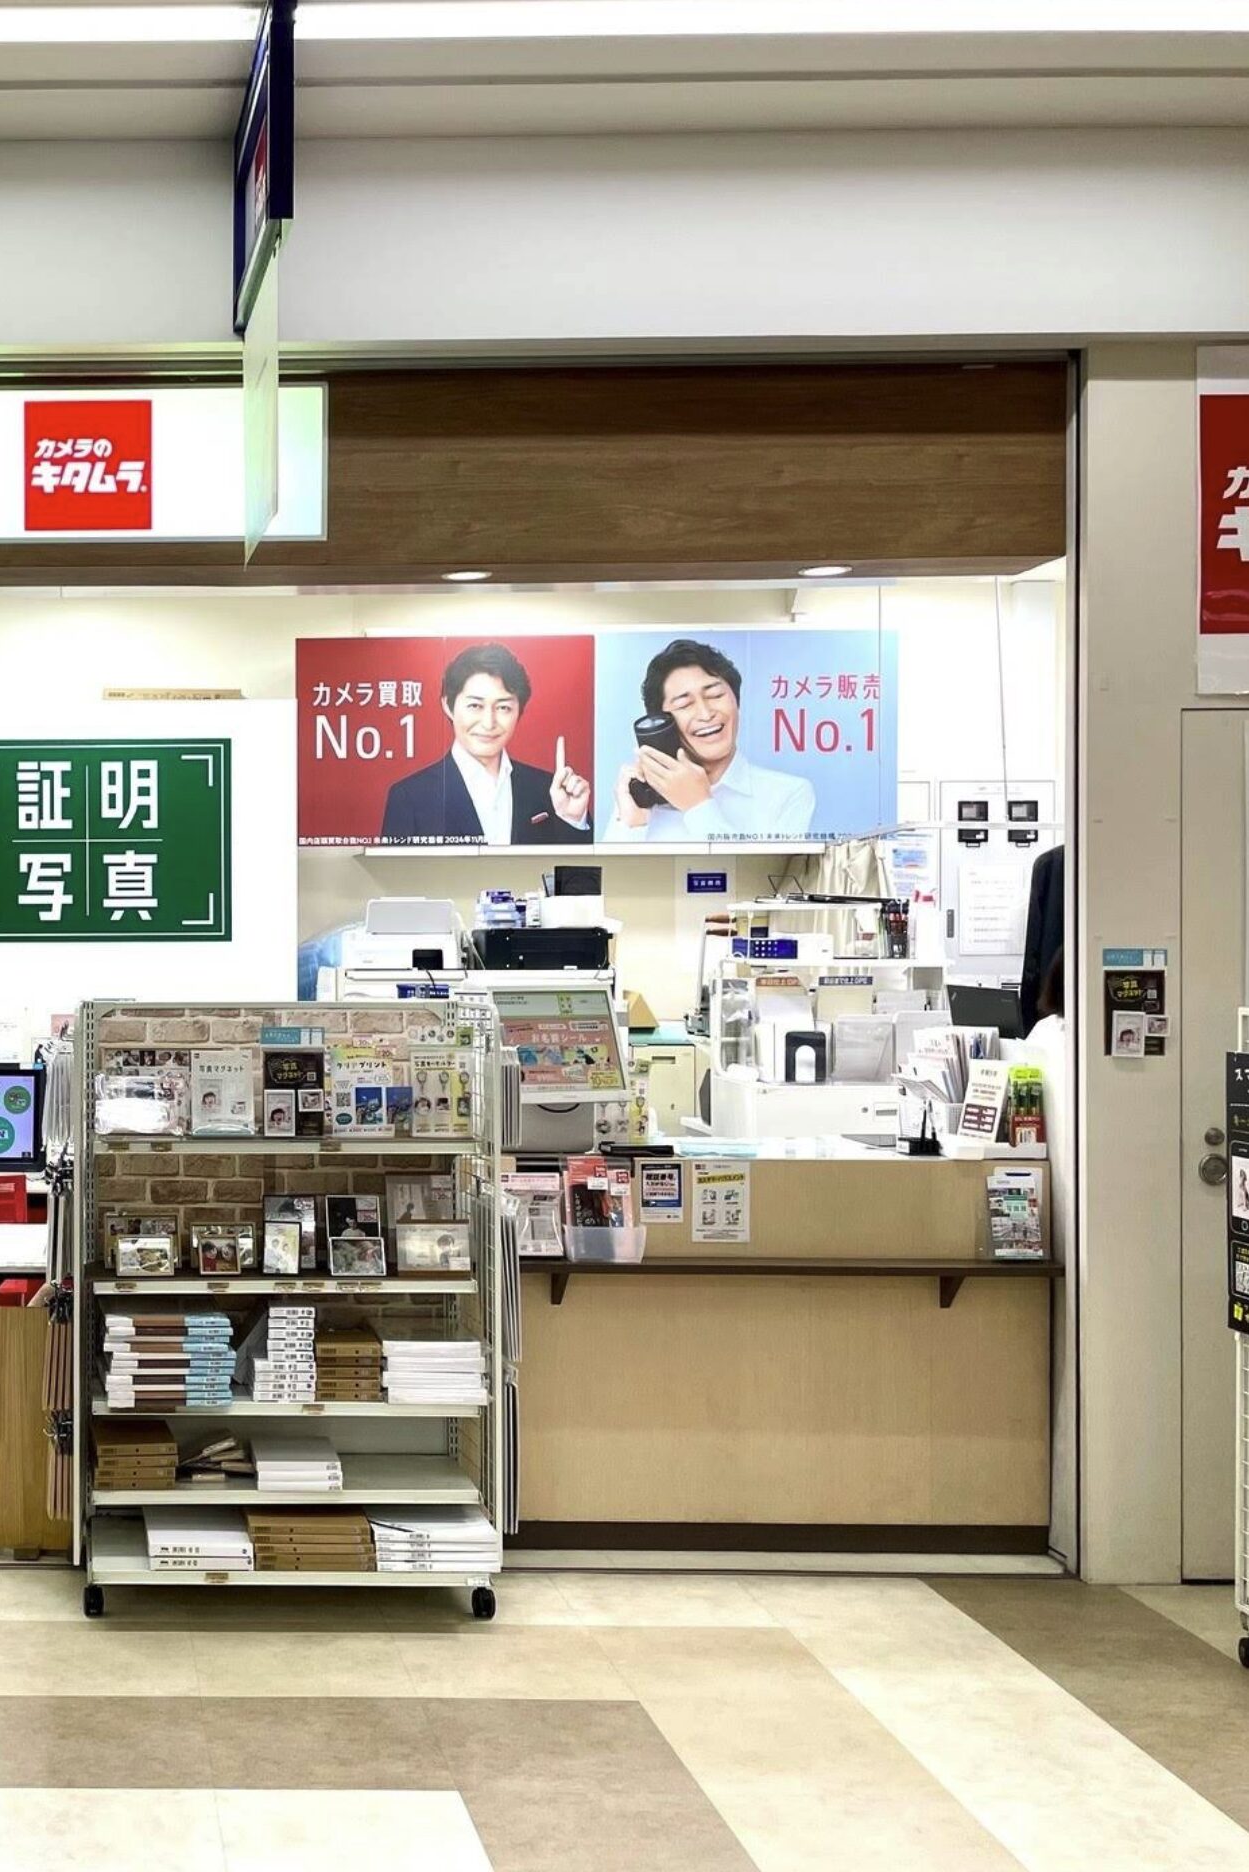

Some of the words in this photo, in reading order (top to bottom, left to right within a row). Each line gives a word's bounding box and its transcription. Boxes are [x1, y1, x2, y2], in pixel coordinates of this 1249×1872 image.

[34, 438, 113, 459] カメラの
[31, 461, 146, 494] キタムラ
[312, 679, 424, 708] カメラ買取
[771, 673, 881, 701] カメラ販売
[314, 714, 416, 760] No.1
[773, 708, 877, 754] No.1
[16, 759, 159, 830] 証明
[17, 849, 159, 922] 写真
